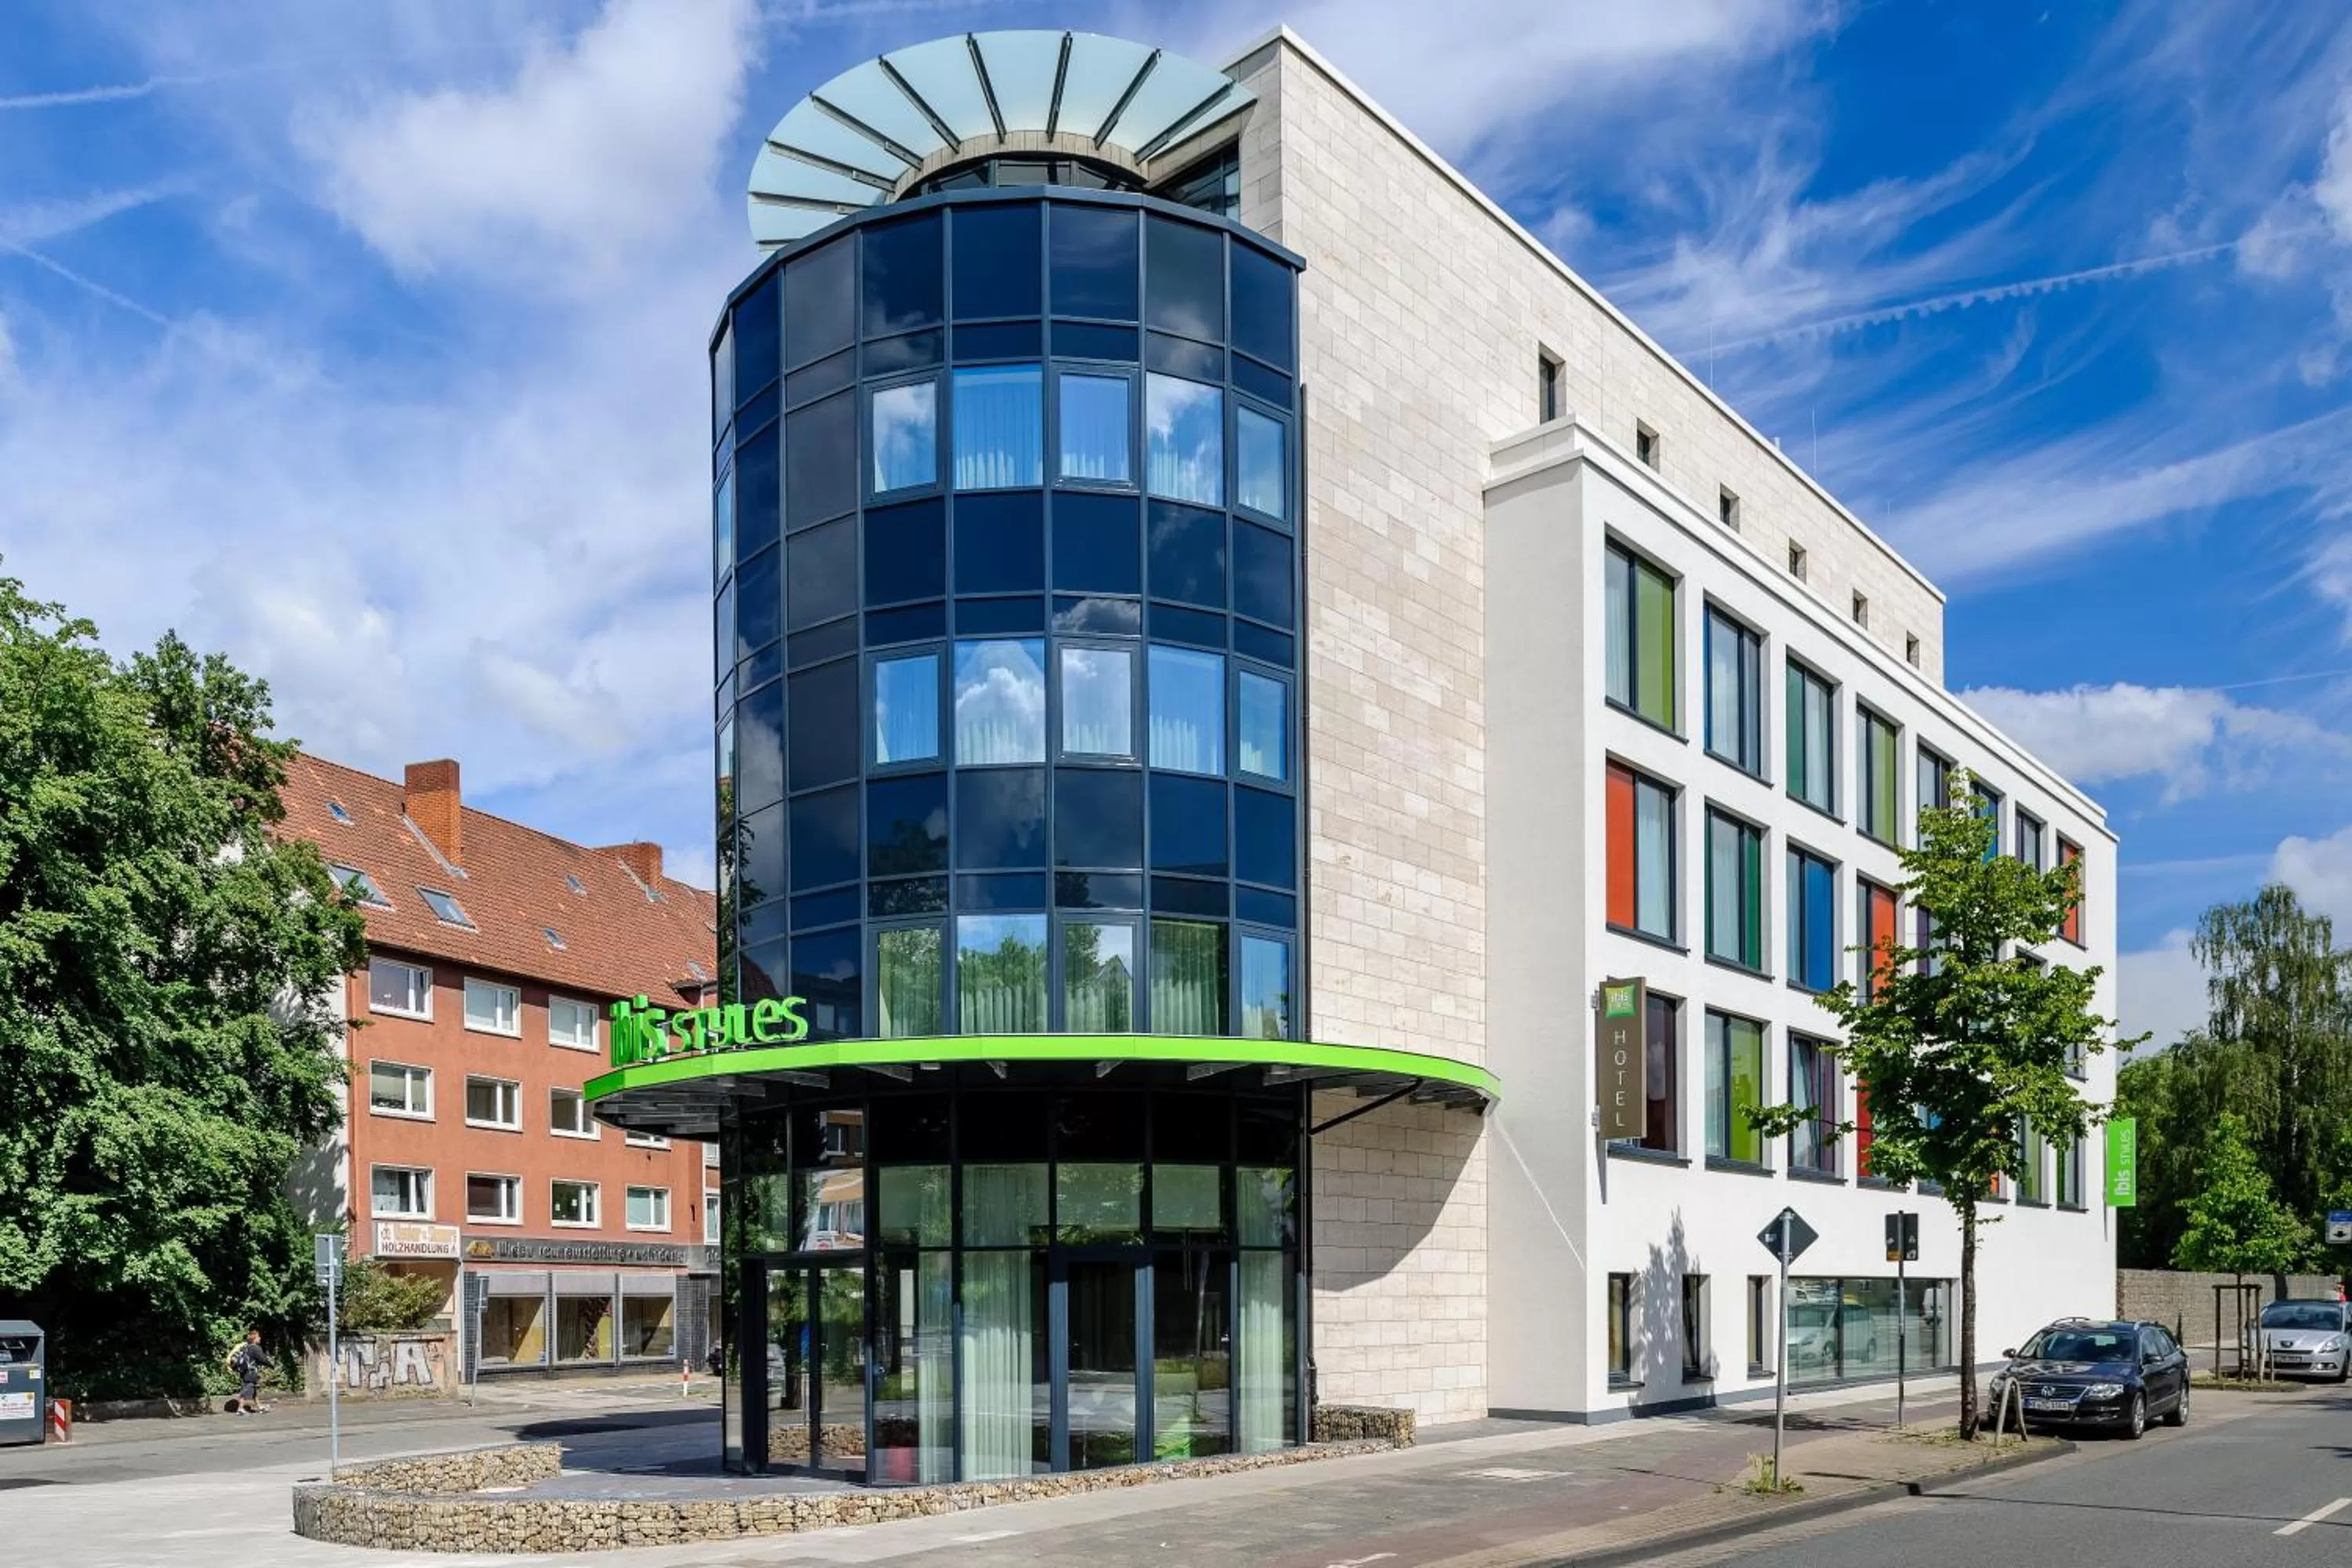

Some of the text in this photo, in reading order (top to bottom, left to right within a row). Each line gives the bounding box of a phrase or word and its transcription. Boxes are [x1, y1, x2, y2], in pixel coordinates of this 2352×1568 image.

[610, 994, 666, 1067] ibis
[1613, 1029, 1628, 1127] HOTEL
[381, 1241, 449, 1254] HOLZHANDLUNG
